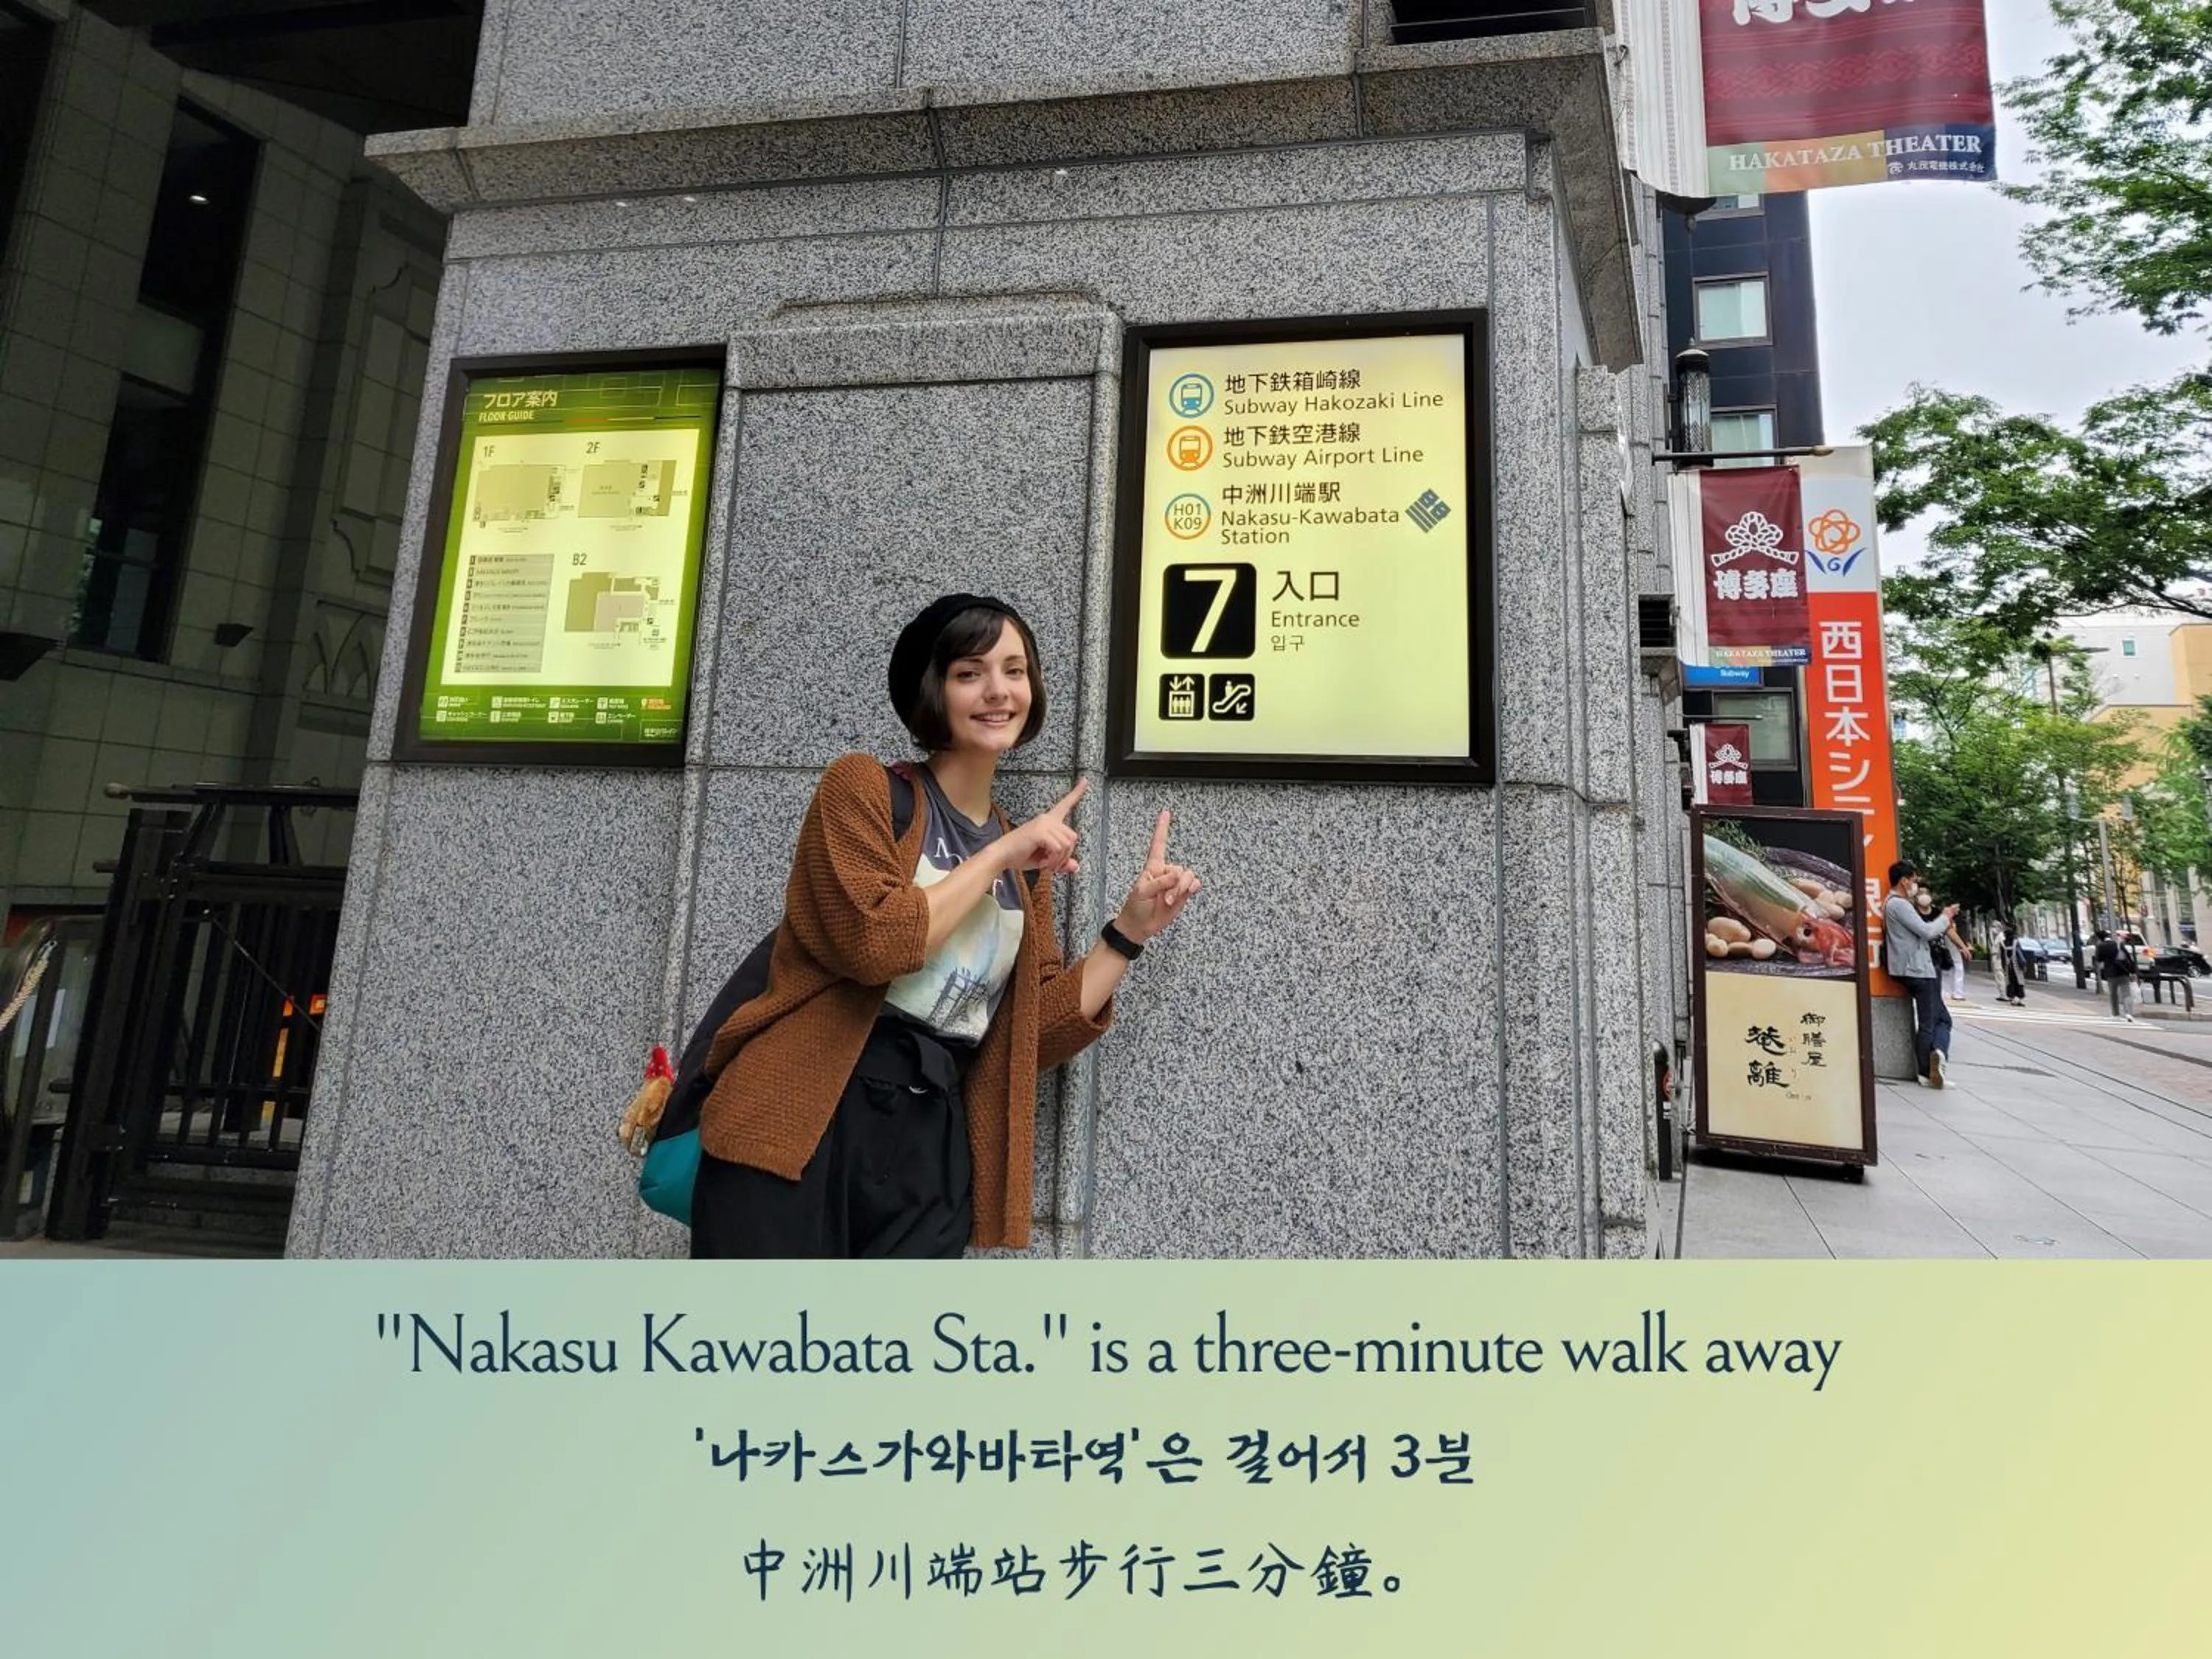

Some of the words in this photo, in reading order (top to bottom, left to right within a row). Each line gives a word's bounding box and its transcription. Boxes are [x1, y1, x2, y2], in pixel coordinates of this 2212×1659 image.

[1729, 145, 1861, 170] HAKATAZA
[1868, 134, 1983, 157] THEATER
[1224, 369, 1360, 394] 地下鉄箱崎線
[482, 389, 558, 408] フロア案内
[1225, 398, 1298, 416] Subway
[1305, 392, 1394, 411] Hakozaki
[1403, 392, 1443, 407] Line
[479, 411, 505, 422] FLOOR
[508, 410, 535, 420] GUIDE
[1224, 422, 1360, 446] 地下鉄空港線
[484, 445, 495, 457] 1F
[586, 442, 600, 453] 2F
[1223, 451, 1296, 470] Subway
[1304, 449, 1374, 467] Airport
[1383, 447, 1423, 462] Line
[1222, 482, 1340, 504] 中洲川端駅
[1174, 504, 1200, 515] H01
[1222, 507, 1399, 526] Nakasu-Kawabata
[1174, 518, 1204, 531] K09
[1222, 528, 1289, 544] Station
[572, 553, 587, 566] B2
[1273, 571, 1339, 602] 入口
[1714, 568, 1799, 600] 博多座
[1185, 569, 1236, 652] 7
[1272, 611, 1360, 627] Entrance
[1271, 635, 1304, 652] 입구
[1719, 669, 1750, 678] Subway
